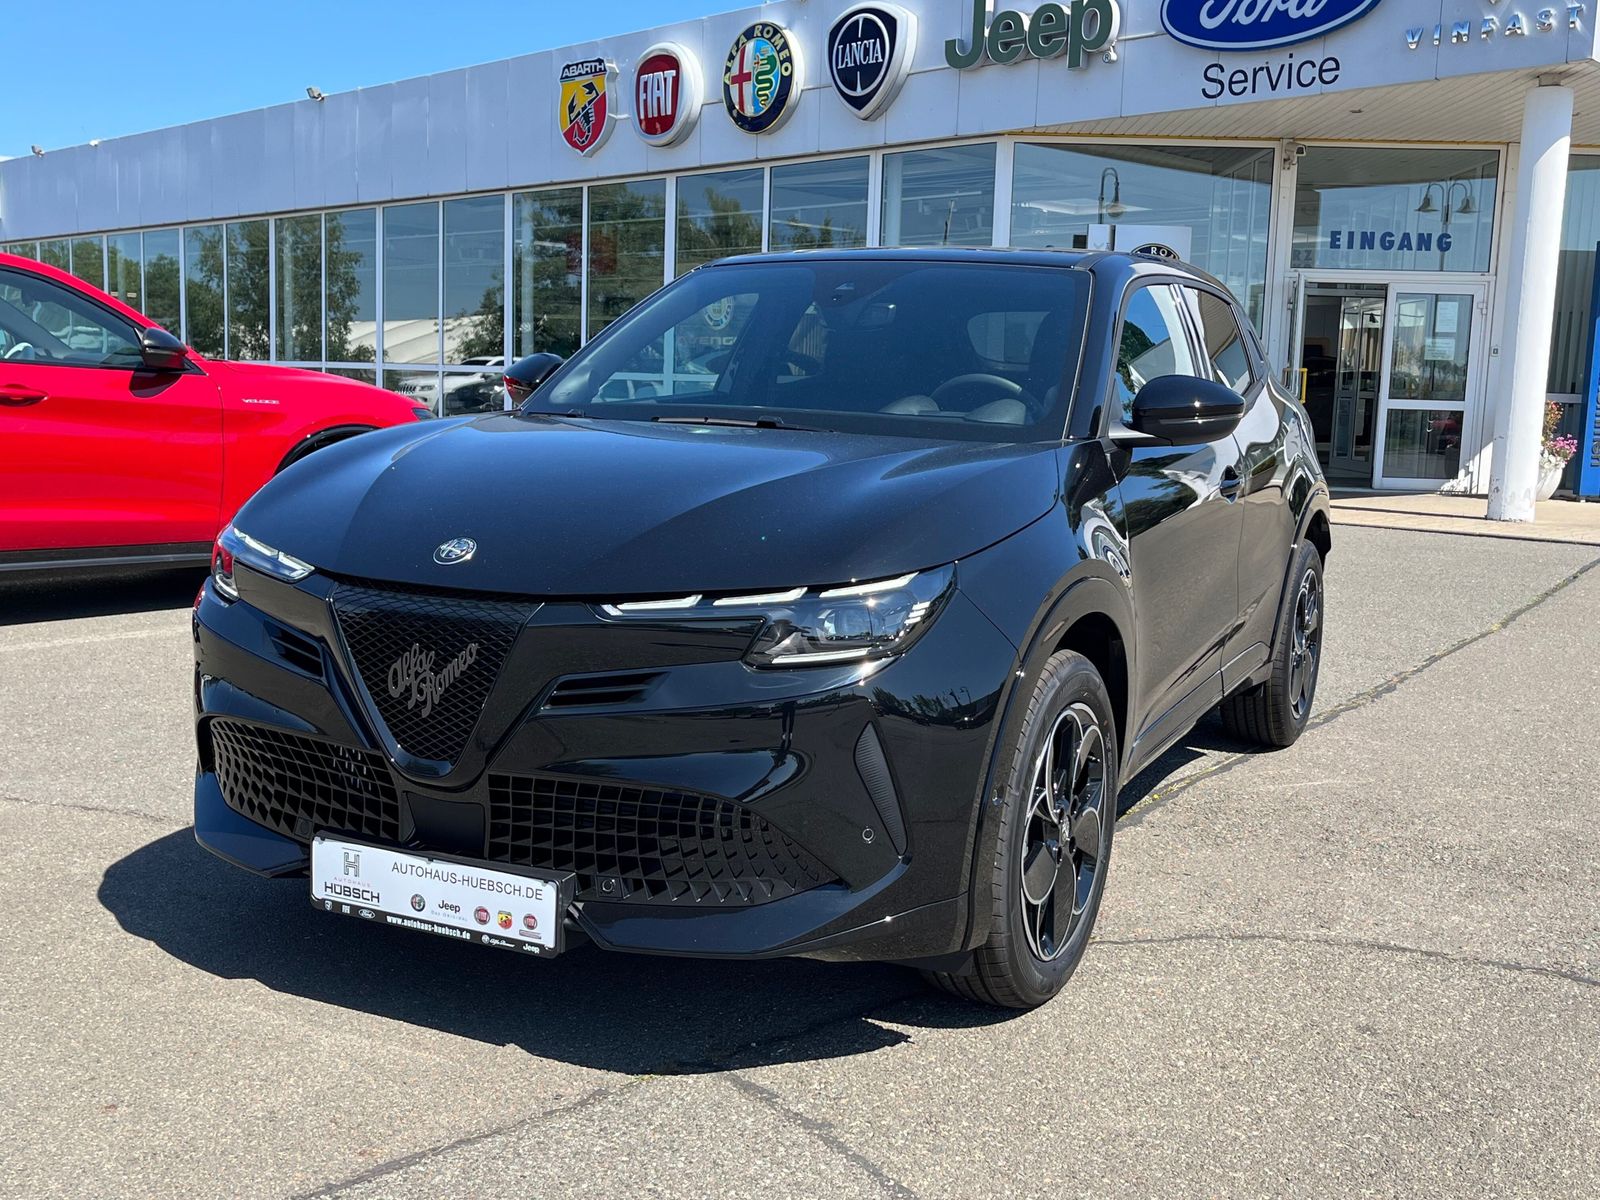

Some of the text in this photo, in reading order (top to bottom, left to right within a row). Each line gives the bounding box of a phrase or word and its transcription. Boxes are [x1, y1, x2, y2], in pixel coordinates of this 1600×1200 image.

[944, 0, 1114, 70] Jeep
[1405, 4, 1586, 50] VINFAST
[562, 62, 605, 78] ABARTH
[723, 24, 792, 85] ALFA ROMEO
[837, 38, 884, 69] LANCIA
[640, 70, 677, 119] FIAT
[1201, 53, 1341, 99] Service
[1329, 230, 1453, 251] EINGANG
[387, 642, 480, 718] Alfa Romeo
[391, 860, 544, 901] AUTOHAUS-HUEBSCH.DE
[386, 915, 471, 940] www.autohaus-huebsch.de
[438, 899, 461, 914] Jeep
